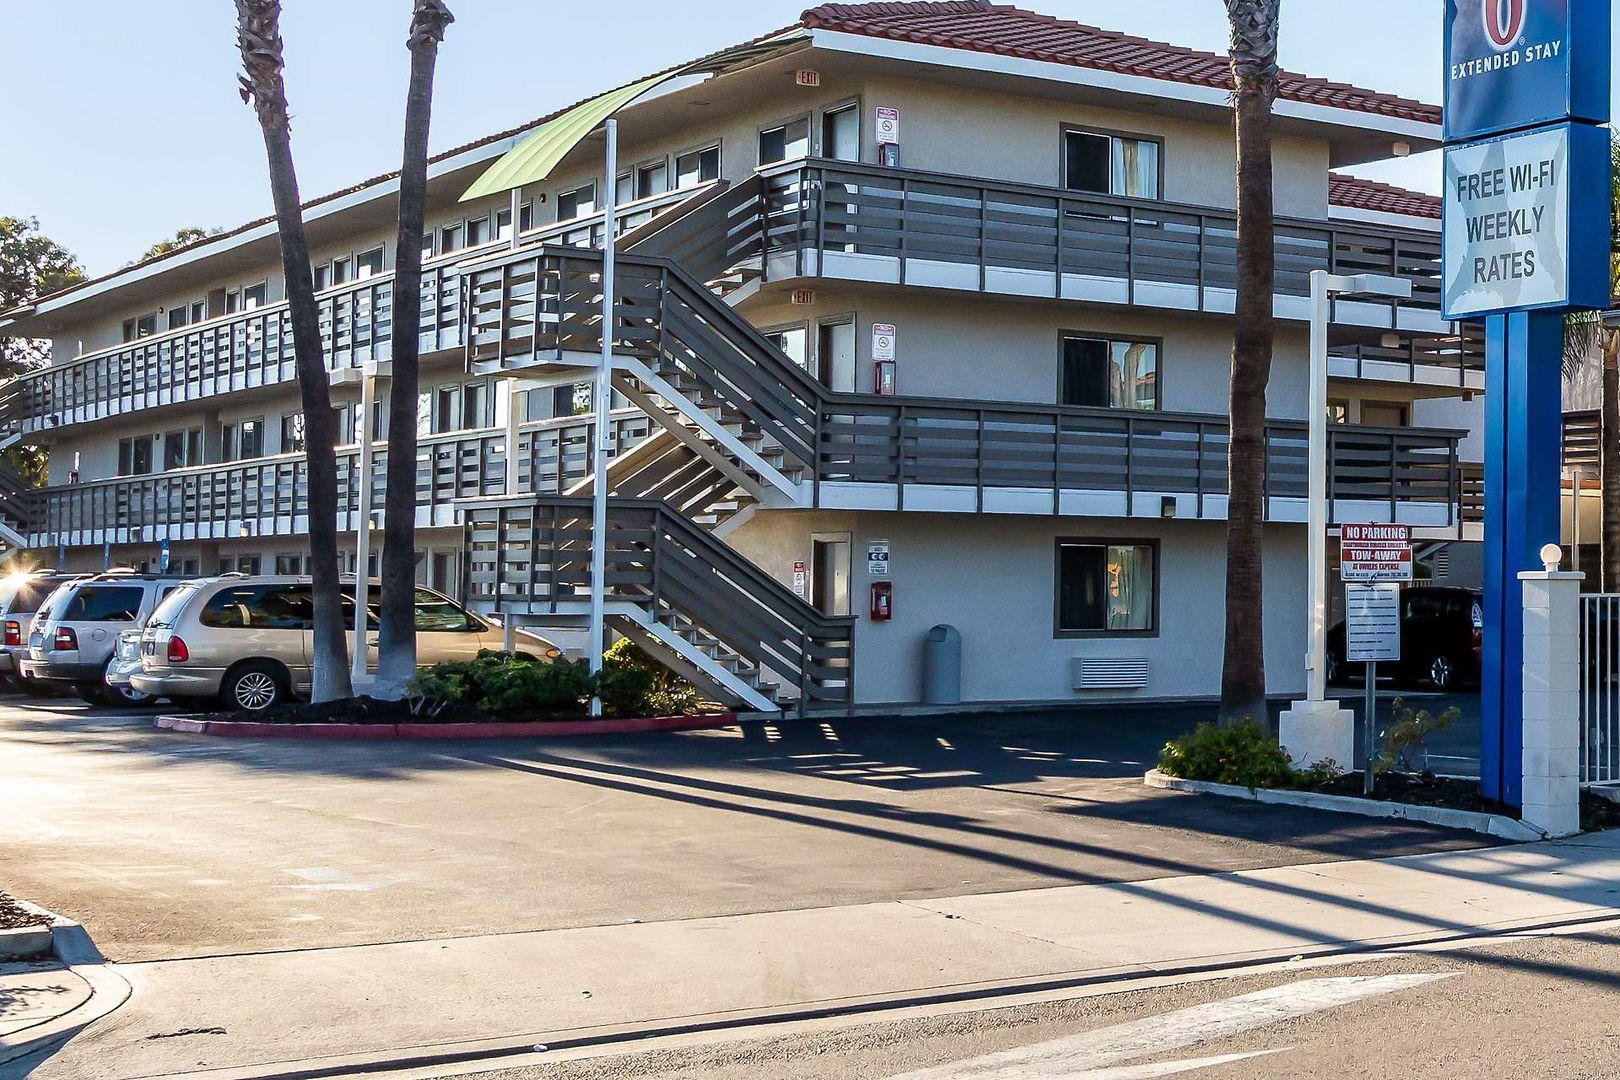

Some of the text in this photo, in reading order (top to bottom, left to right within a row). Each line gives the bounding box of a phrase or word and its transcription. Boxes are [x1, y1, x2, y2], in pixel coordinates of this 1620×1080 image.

[801, 70, 816, 84] EXIT
[1451, 40, 1561, 80] EXTENDED STAY
[1457, 160, 1555, 202] FREE WI-FI
[1466, 206, 1545, 243] WEEKLY
[1474, 250, 1535, 284] RATES
[1346, 527, 1406, 539] NO PARKING
[1351, 550, 1401, 560] TOW-AWAY
